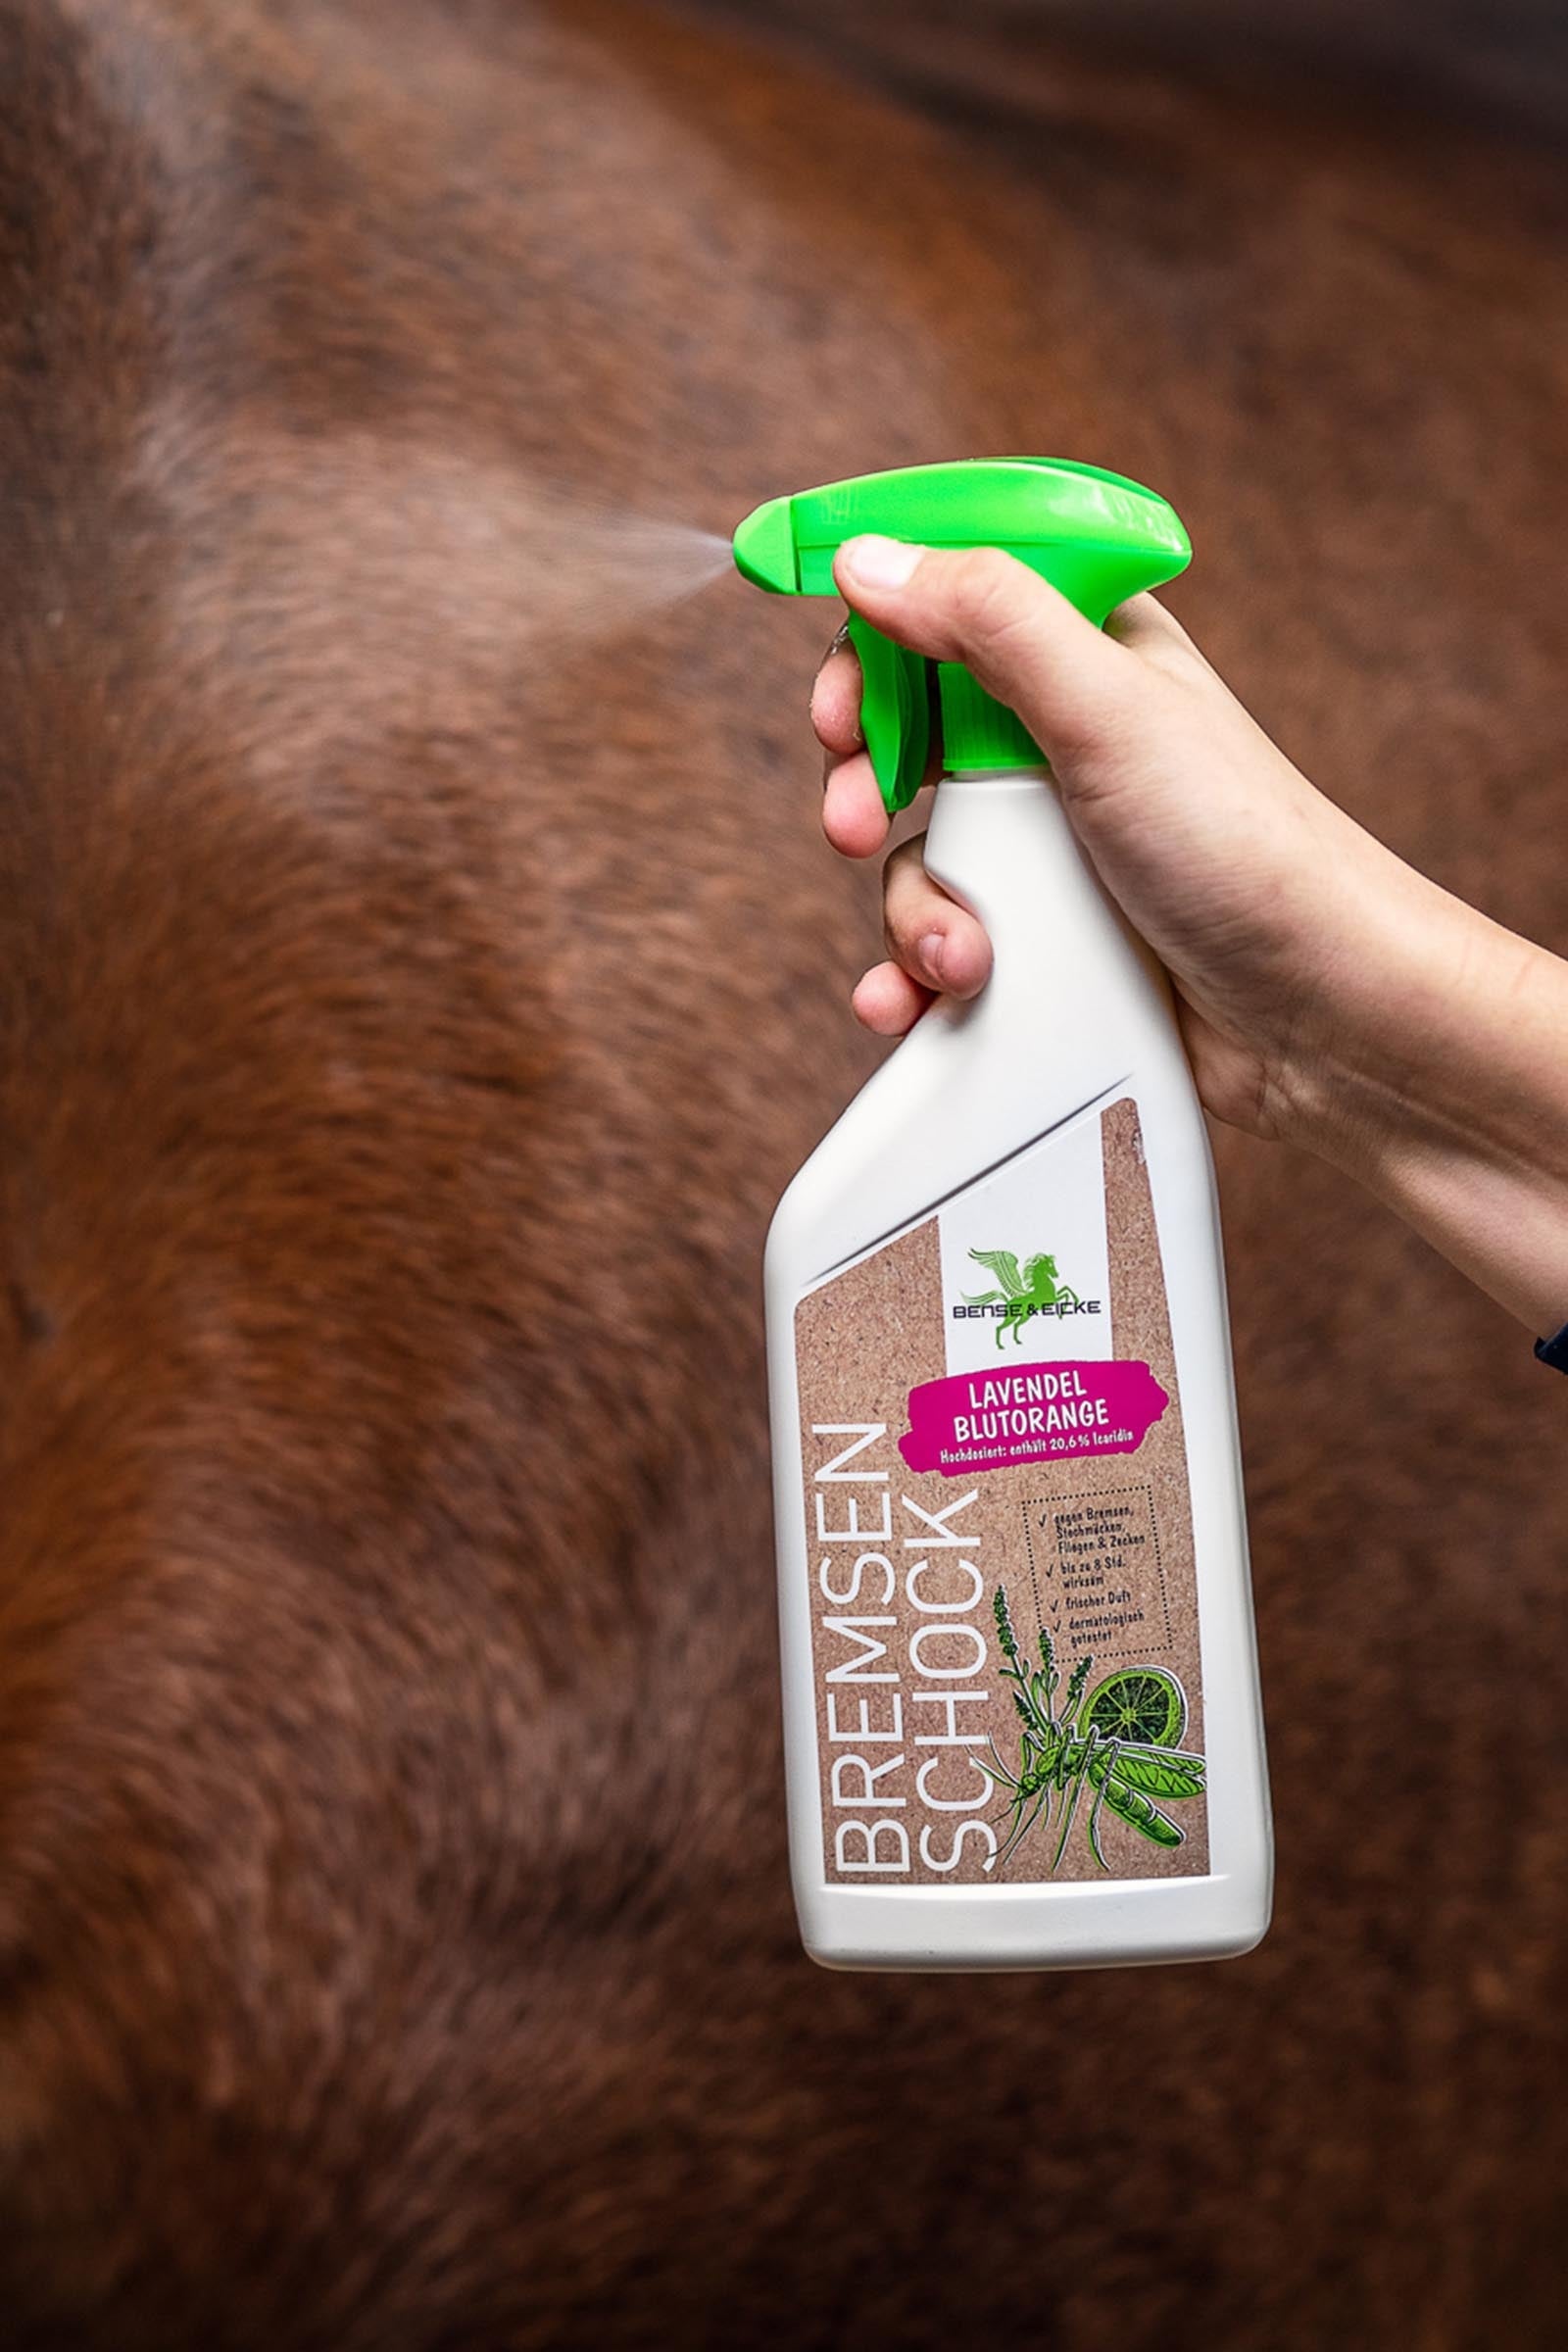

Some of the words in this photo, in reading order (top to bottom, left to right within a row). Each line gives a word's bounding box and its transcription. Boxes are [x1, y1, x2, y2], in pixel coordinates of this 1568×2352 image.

[953, 1304, 1023, 1319] BENSE
[1026, 1304, 1039, 1316] &
[1042, 1300, 1102, 1315] EICKE
[968, 1370, 1087, 1409] LAVENDEL
[954, 1398, 1109, 1443] BLUTORANGE
[940, 1446, 1006, 1464] Hochdosiert:
[1009, 1440, 1047, 1456] enthält
[1050, 1435, 1077, 1451] 20,6
[1093, 1429, 1134, 1446] Icaridin
[1054, 1512, 1083, 1526] gegen
[1086, 1506, 1134, 1521] Bremsen,
[1058, 1541, 1095, 1555] Fliegen
[1098, 1536, 1106, 1548] &
[1109, 1533, 1145, 1548] Zecken
[1060, 1561, 1076, 1574] bis
[1094, 1558, 1102, 1571] 8
[1104, 1554, 1126, 1569] Std.
[1062, 1575, 1103, 1589] wirksam
[1065, 1594, 1104, 1609] frischer
[1107, 1590, 1131, 1604] Duft
[1069, 1609, 1145, 1630] dermatologisch
[811, 1423, 911, 1873] BREMSEN
[902, 1489, 998, 1873] SCHOCK
